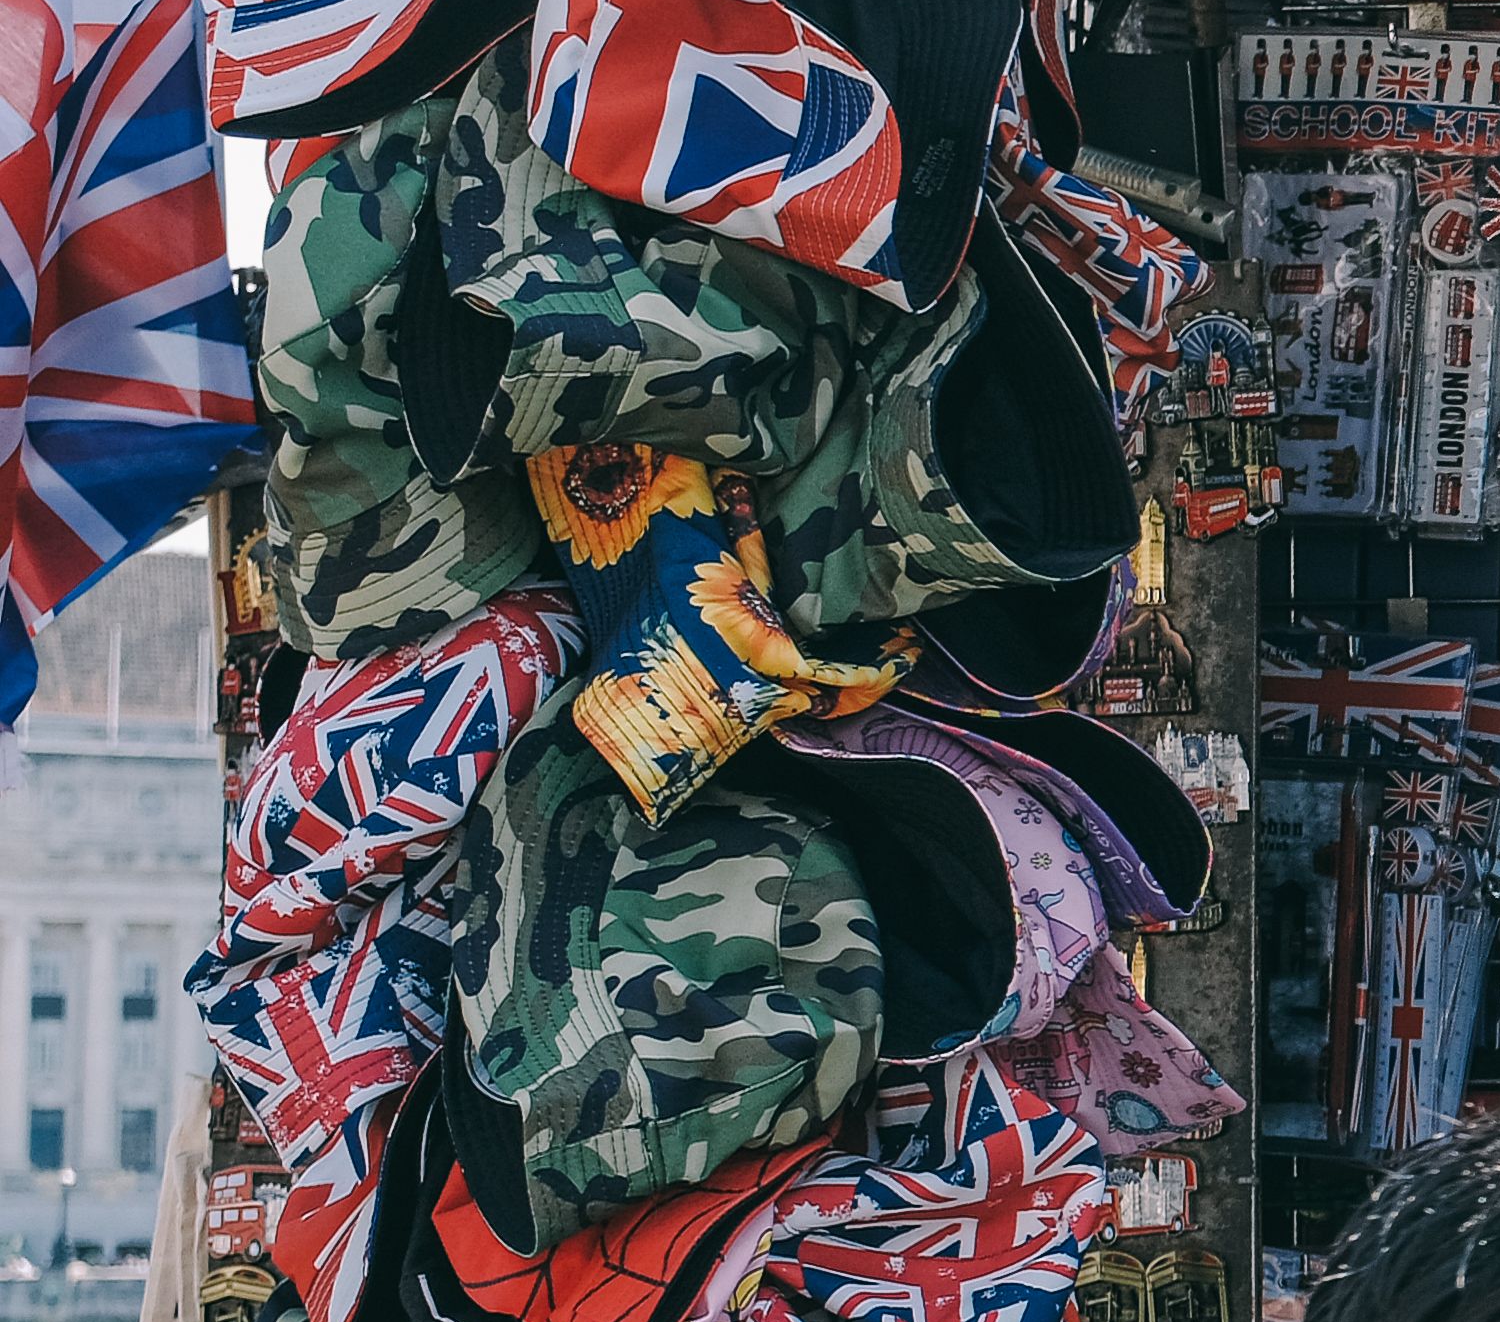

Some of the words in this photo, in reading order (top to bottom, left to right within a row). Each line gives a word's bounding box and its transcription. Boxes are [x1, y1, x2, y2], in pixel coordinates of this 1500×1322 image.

[1245, 105, 1420, 144] SCHOOL
[1302, 305, 1324, 403] London
[1436, 370, 1470, 469] LONDON
